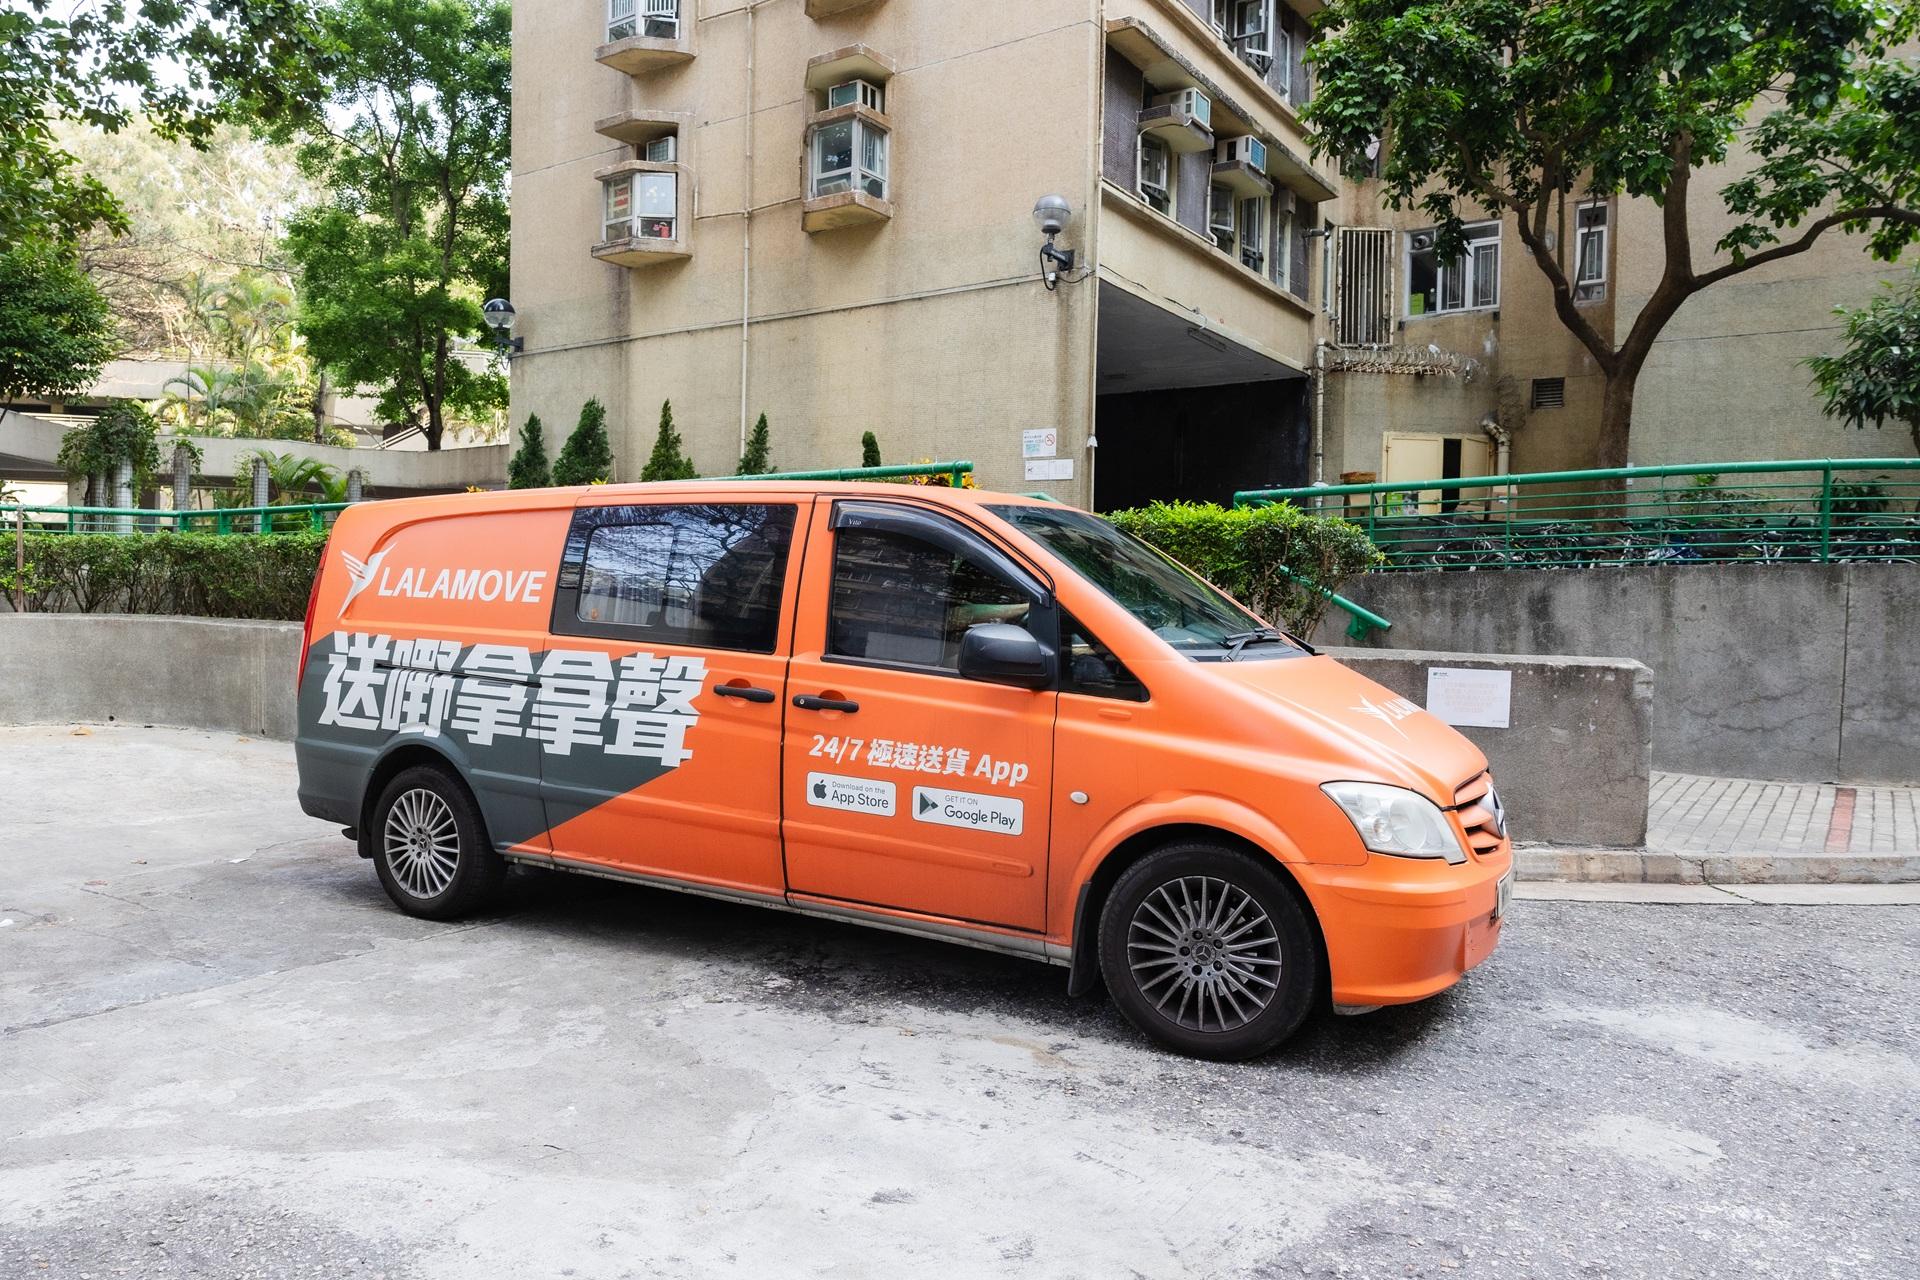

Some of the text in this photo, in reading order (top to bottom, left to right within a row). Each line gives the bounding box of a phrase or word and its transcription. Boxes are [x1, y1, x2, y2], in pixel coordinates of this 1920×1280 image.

[378, 568, 547, 603] LALAMOVE
[318, 631, 709, 768] 送嘢拿拿聲
[809, 734, 1028, 787] 24/7 極速送貨 App
[831, 781, 864, 792] Download
[874, 787, 886, 795] the
[831, 789, 889, 809] App Store
[944, 794, 979, 806] GET IT ON
[944, 804, 1016, 830] Google Play
